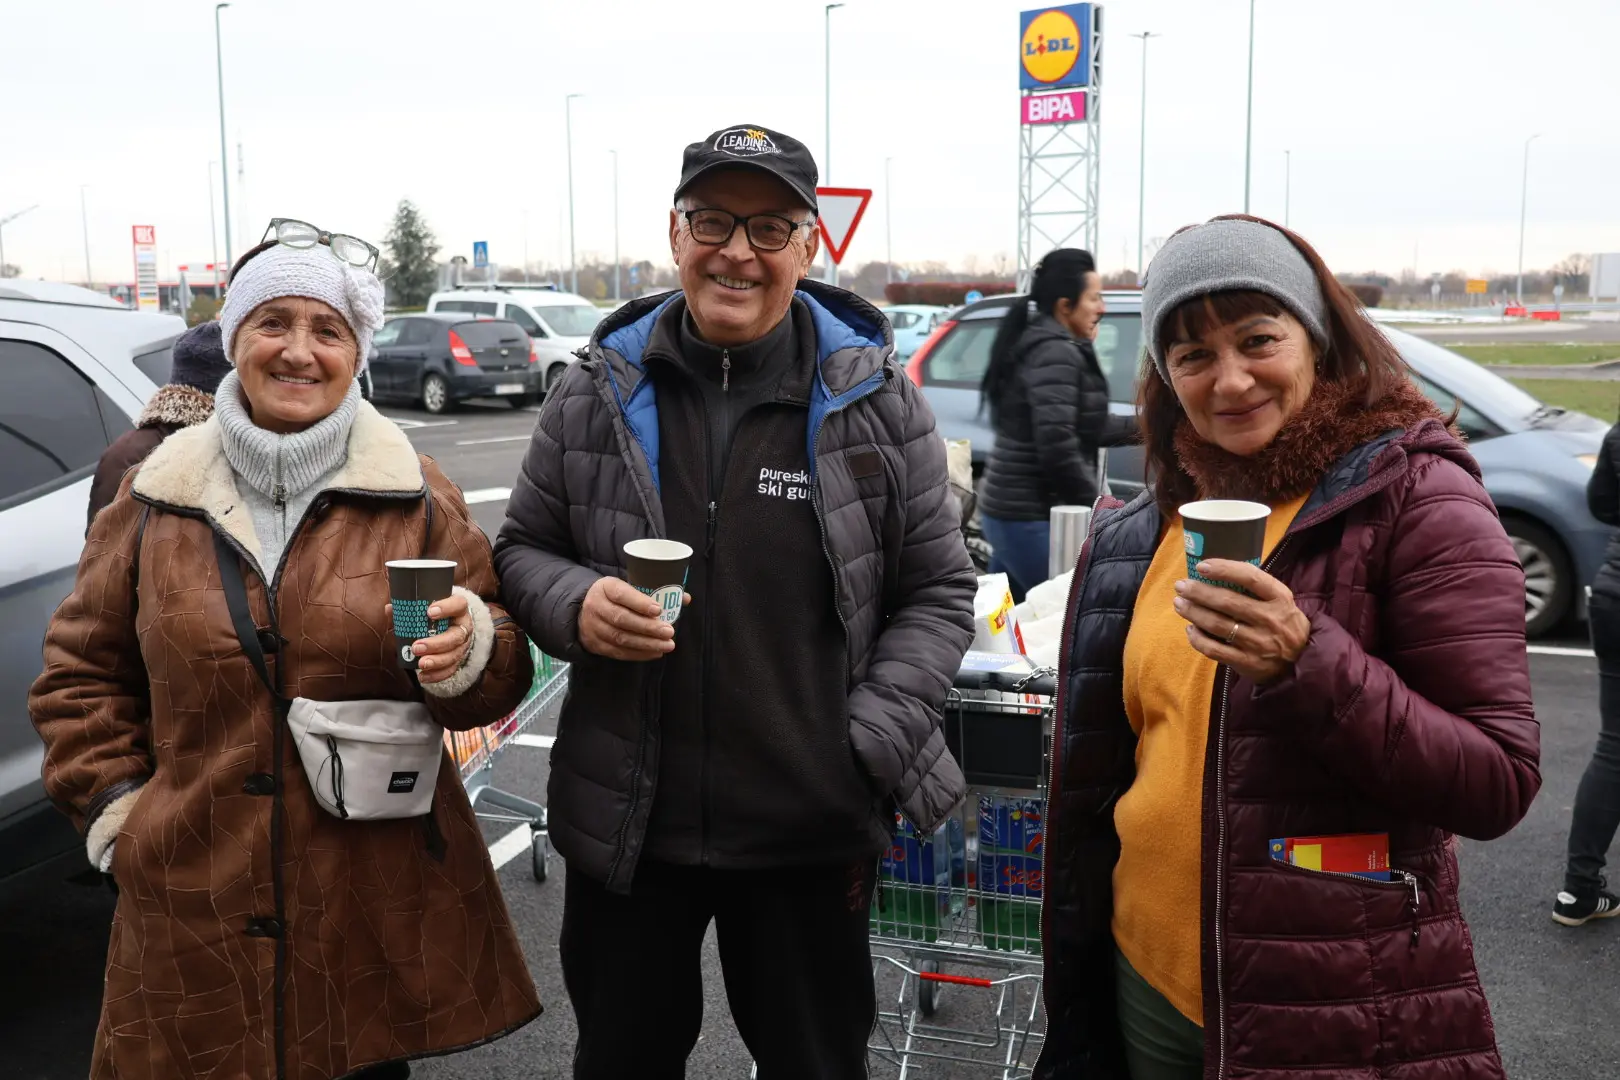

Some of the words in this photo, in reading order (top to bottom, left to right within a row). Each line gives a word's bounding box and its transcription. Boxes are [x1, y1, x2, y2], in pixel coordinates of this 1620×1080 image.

[1025, 34, 1075, 57] LIDL
[1028, 96, 1075, 121] BIPA
[758, 480, 782, 497] ski
[786, 486, 811, 501] gui
